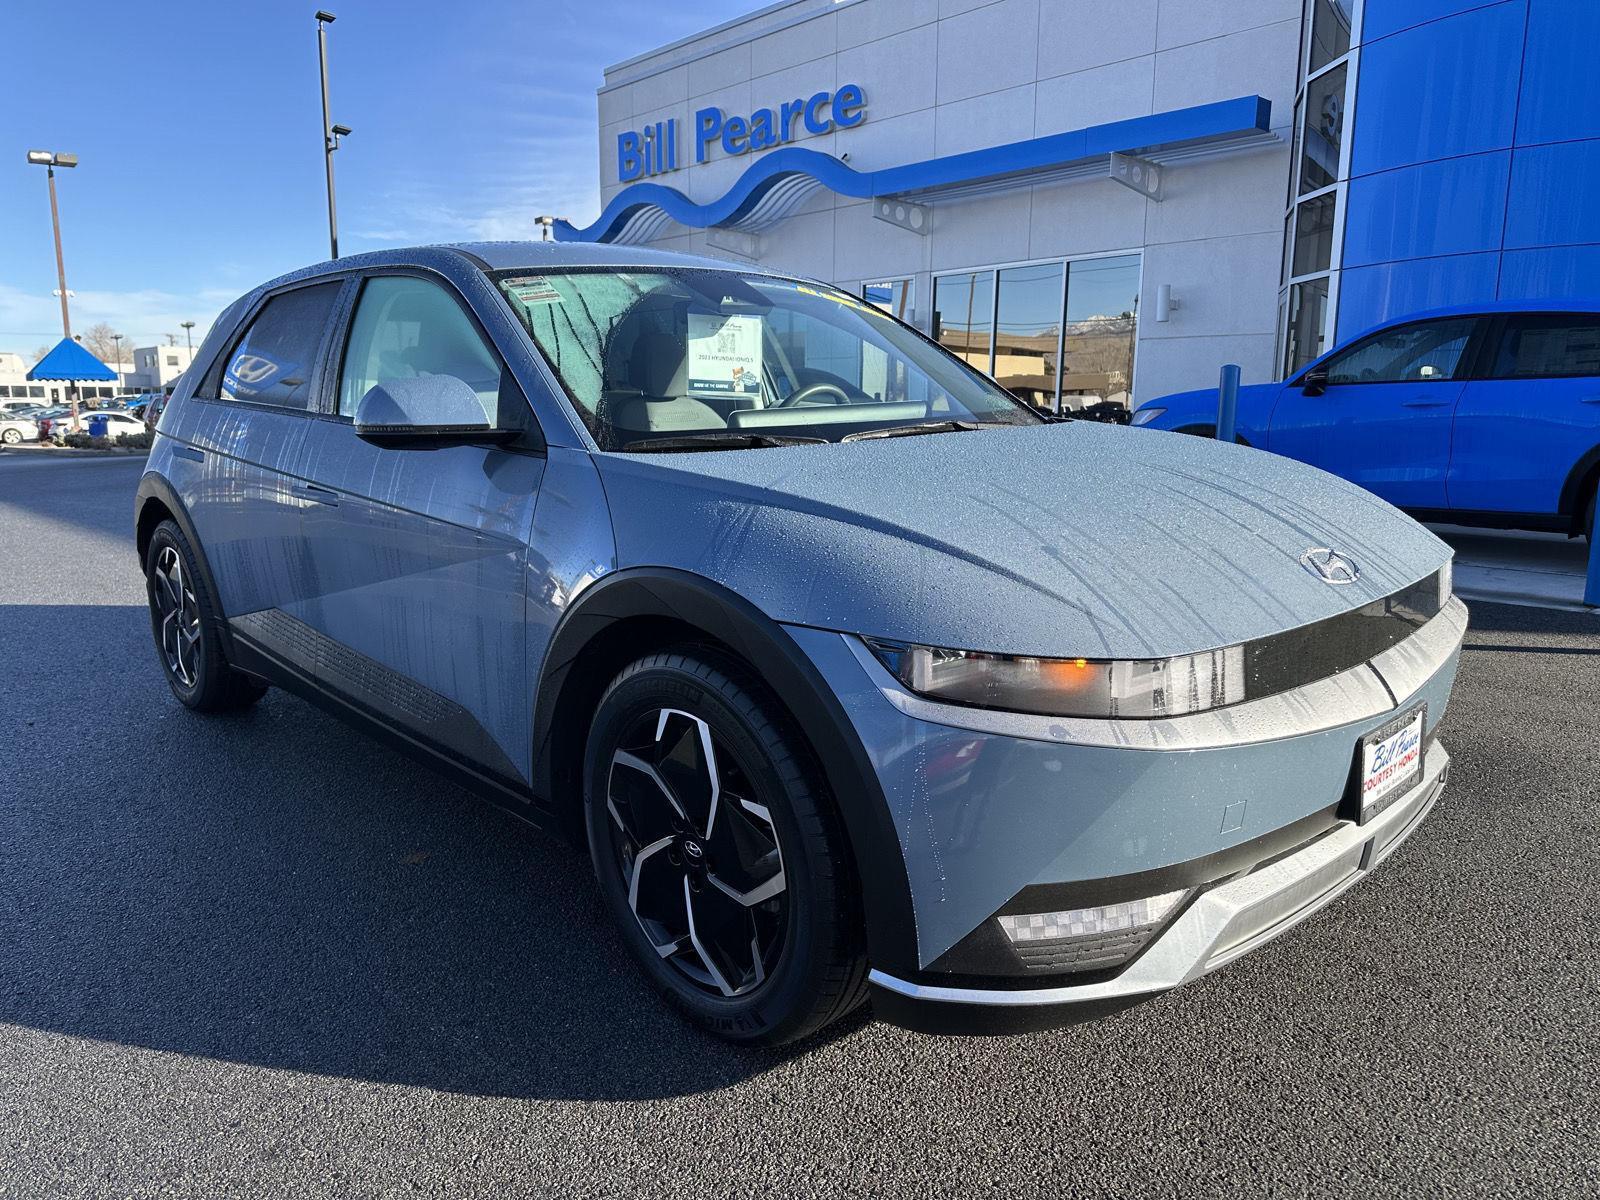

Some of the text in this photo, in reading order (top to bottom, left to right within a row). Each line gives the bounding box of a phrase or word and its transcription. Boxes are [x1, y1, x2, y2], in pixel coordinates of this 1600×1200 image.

[617, 84, 867, 182] Bill Pearce
[1371, 729, 1419, 774] Bill Pearce
[1398, 747, 1418, 768] HONDA
